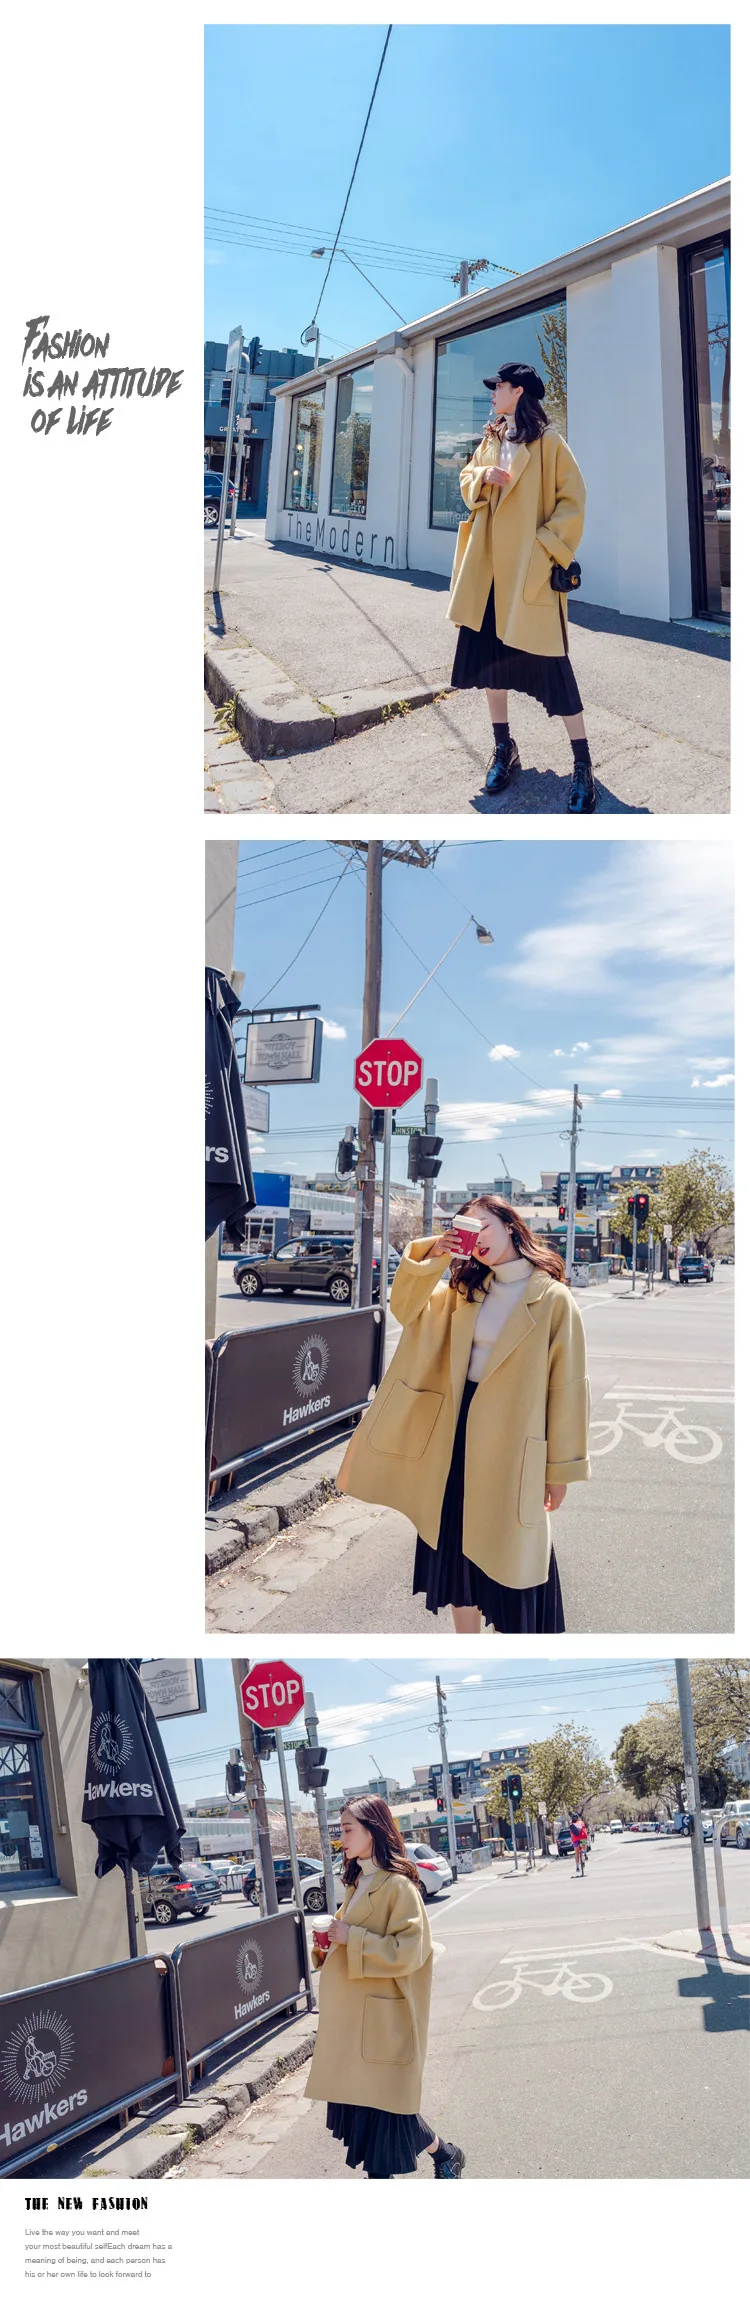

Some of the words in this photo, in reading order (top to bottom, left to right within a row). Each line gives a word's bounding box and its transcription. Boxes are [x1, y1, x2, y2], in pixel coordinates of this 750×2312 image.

[264, 1041, 296, 1051] FITZROY
[358, 1060, 419, 1087] STOP
[392, 1127, 423, 1136] OHNSTON
[205, 1145, 229, 1163] rs
[282, 1394, 331, 1426] Hawkers
[245, 1679, 300, 1711] STOP
[283, 1741, 303, 1750] NSTON
[304, 1740, 310, 1748] S
[84, 1780, 153, 1801] Hawkers
[219, 1874, 243, 1892] SAM
[234, 1990, 271, 2020] Hawkers
[0, 2088, 88, 2148] Hawkers
